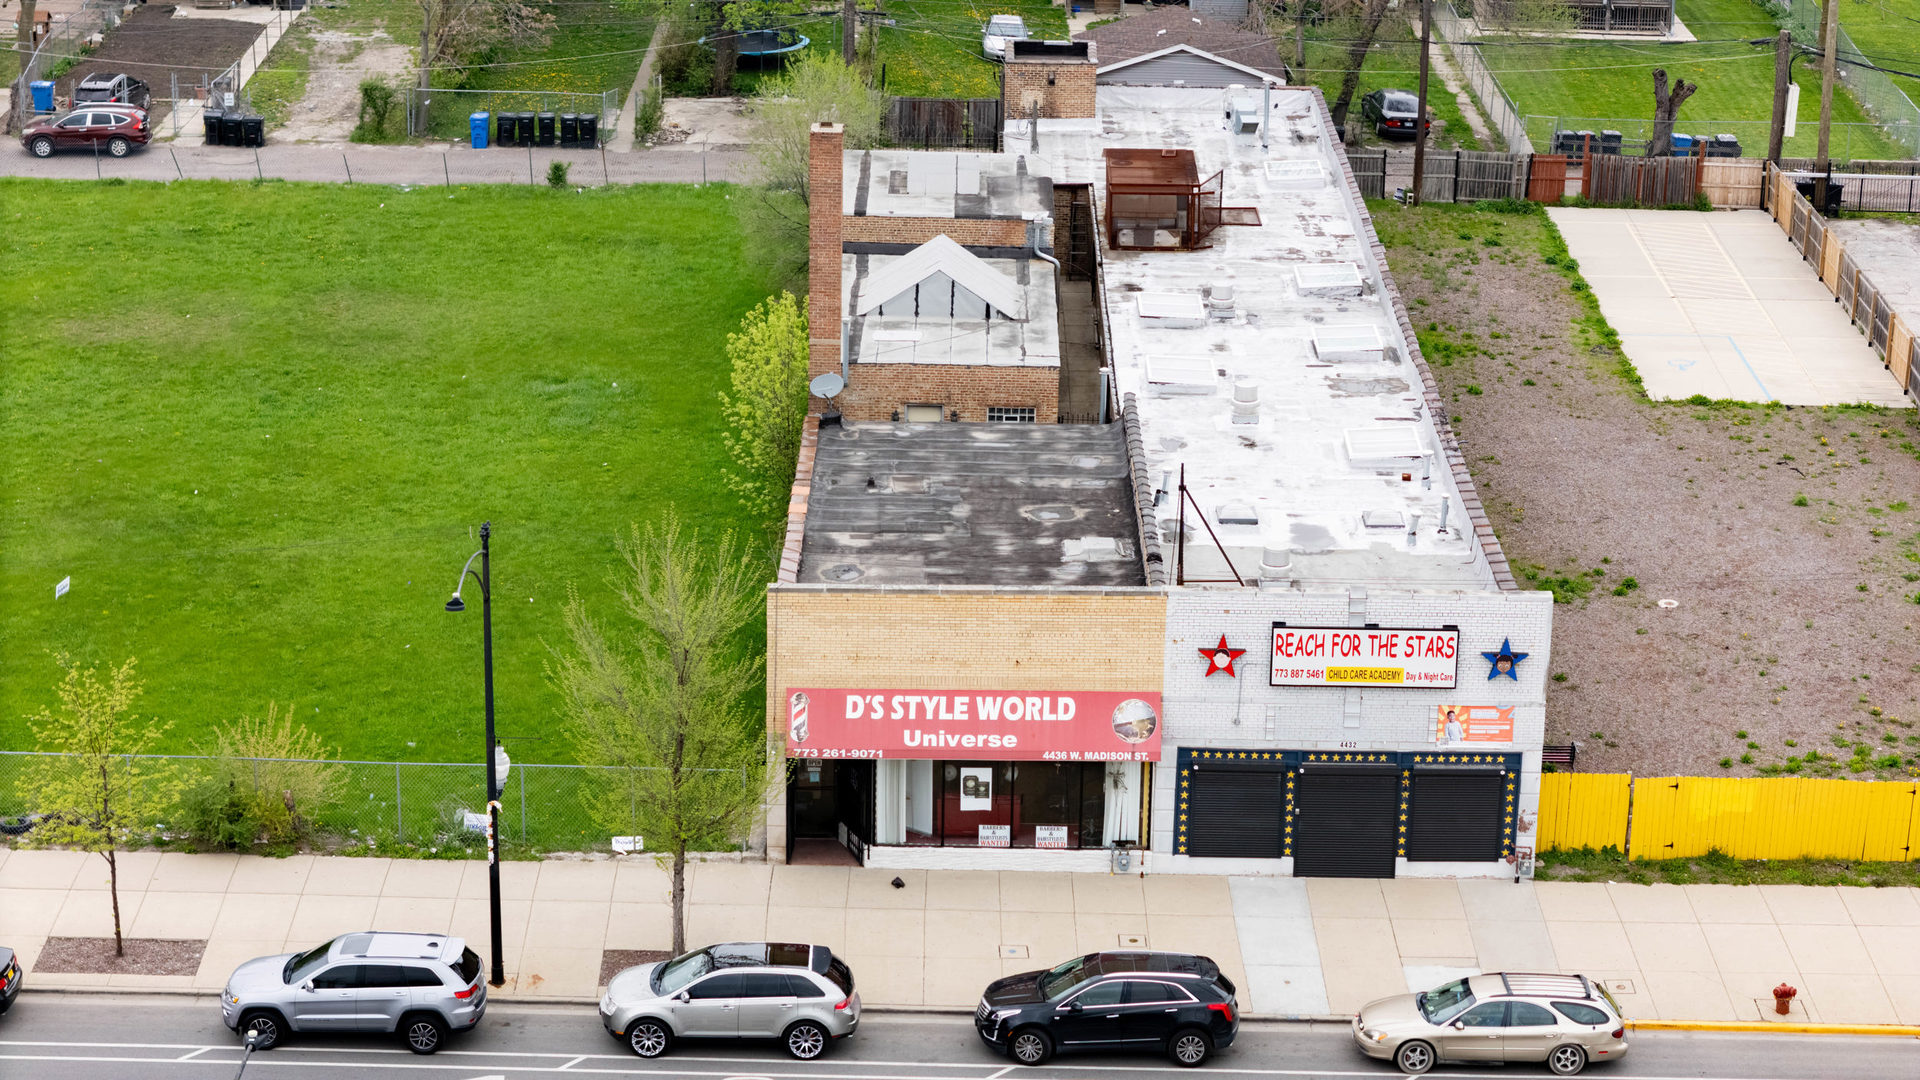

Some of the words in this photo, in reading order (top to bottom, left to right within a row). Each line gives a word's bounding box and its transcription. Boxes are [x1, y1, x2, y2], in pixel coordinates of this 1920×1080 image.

[1276, 633, 1325, 657] REACH
[1332, 633, 1360, 658] FOR
[1368, 634, 1398, 658] THE
[1404, 635, 1455, 658] STARS
[1275, 669, 1288, 678] 773
[1290, 669, 1304, 678] 887
[1306, 669, 1324, 678] 5461
[1328, 669, 1348, 679] CHILD
[1349, 670, 1367, 679] CARE
[1368, 670, 1401, 680] ACADEMY
[1405, 672, 1416, 682] Day
[1418, 672, 1422, 680] &
[1423, 672, 1439, 682] Night
[1440, 672, 1454, 681] Care
[846, 695, 885, 720] D'S
[890, 695, 969, 720] STYLE
[976, 696, 1076, 721] WORLD
[903, 729, 1018, 748] Universe
[793, 748, 818, 757] 773
[822, 749, 883, 758] 261-9071
[1043, 751, 1067, 760] 4436
[1069, 752, 1082, 760] W.
[1084, 752, 1132, 760] MADISON
[1134, 752, 1149, 761] ST.
